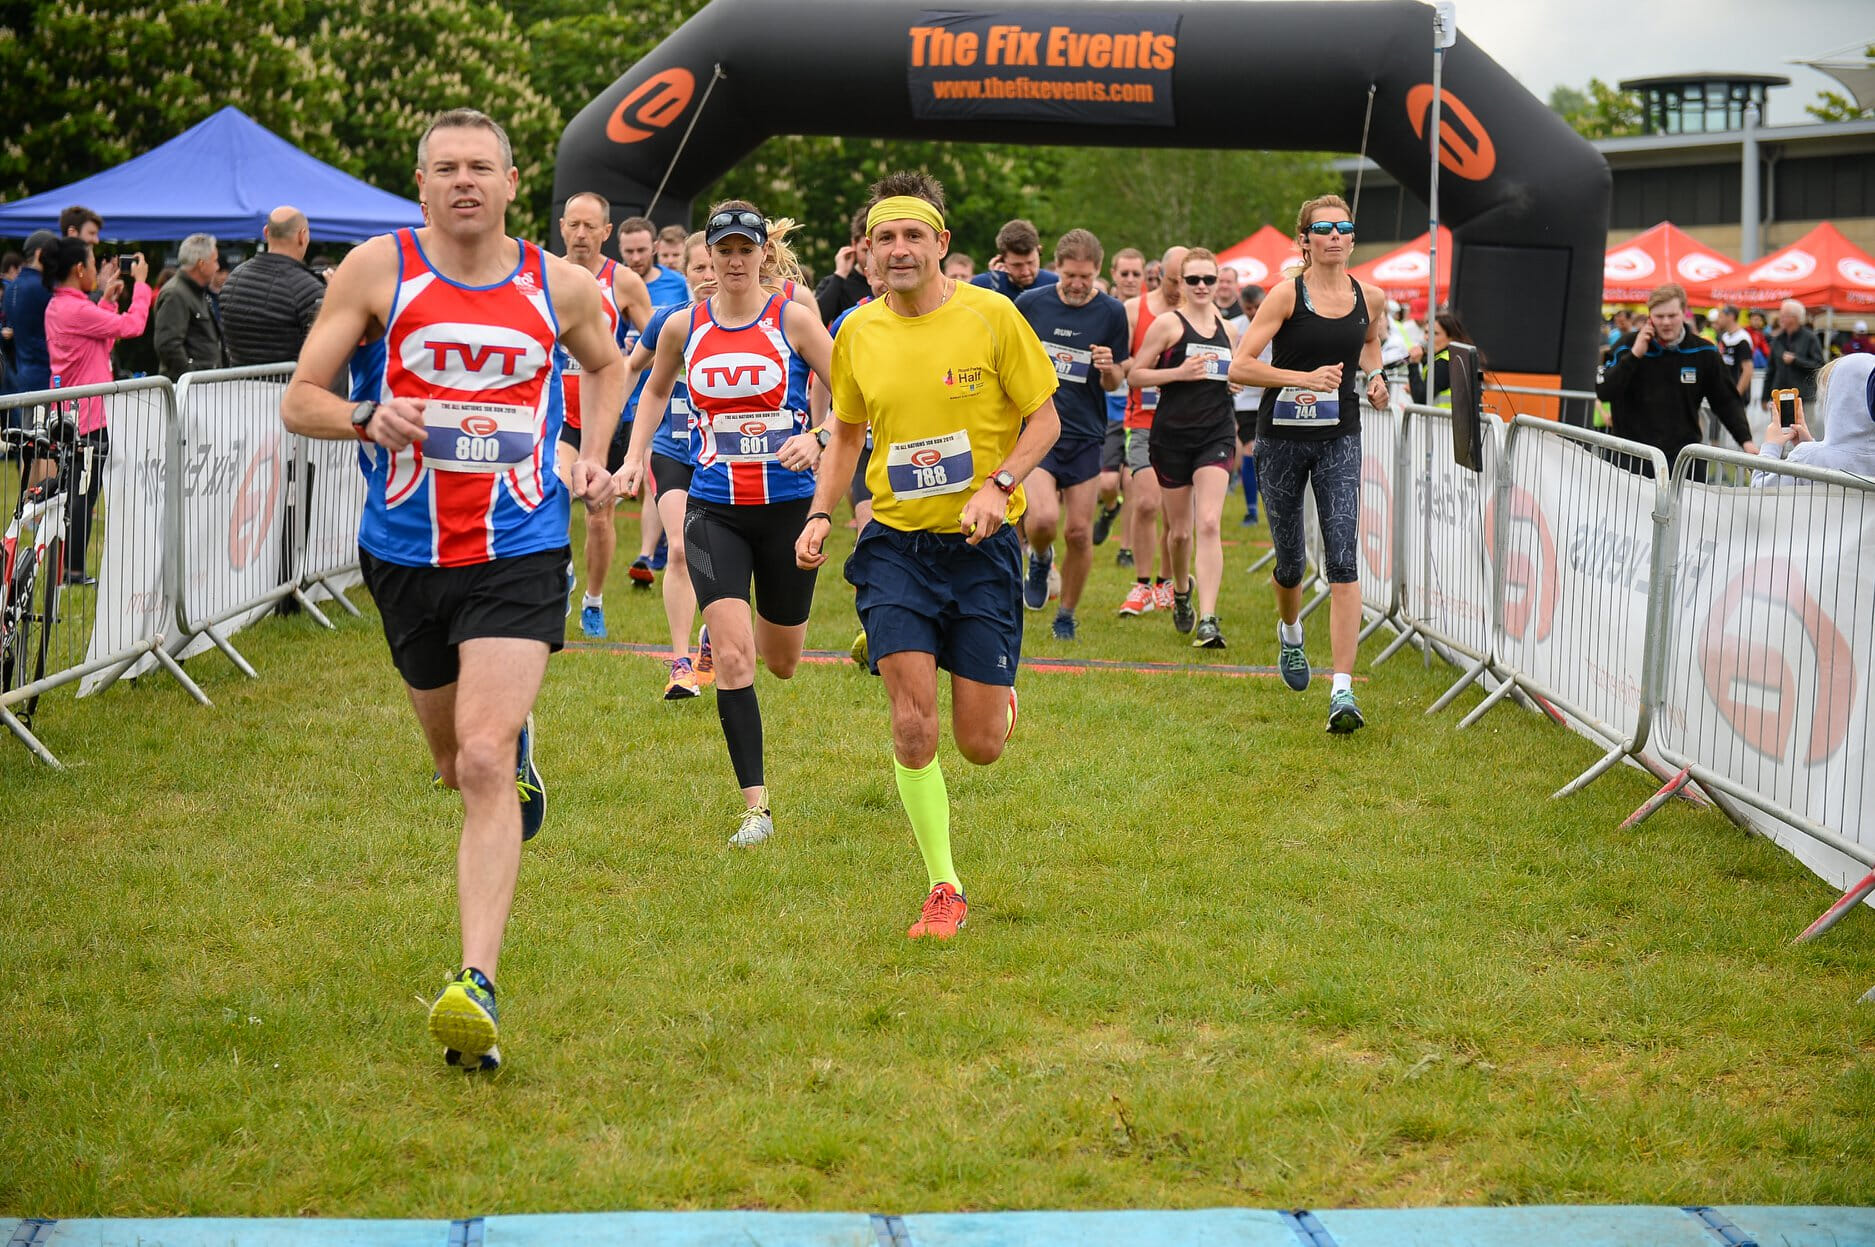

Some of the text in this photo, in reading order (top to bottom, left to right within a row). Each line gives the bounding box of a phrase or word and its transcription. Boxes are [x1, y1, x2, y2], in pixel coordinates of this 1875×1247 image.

[908, 26, 1177, 70] The Fix Events
[932, 76, 1154, 103] www.thefixevents.com
[1053, 328, 1073, 337] RUN
[424, 341, 527, 376] TVT
[702, 365, 766, 387] TVT
[958, 371, 981, 383] Half
[1294, 405, 1317, 419] 744
[455, 436, 500, 462] 800
[740, 436, 769, 454] 801
[912, 465, 948, 488] 788
